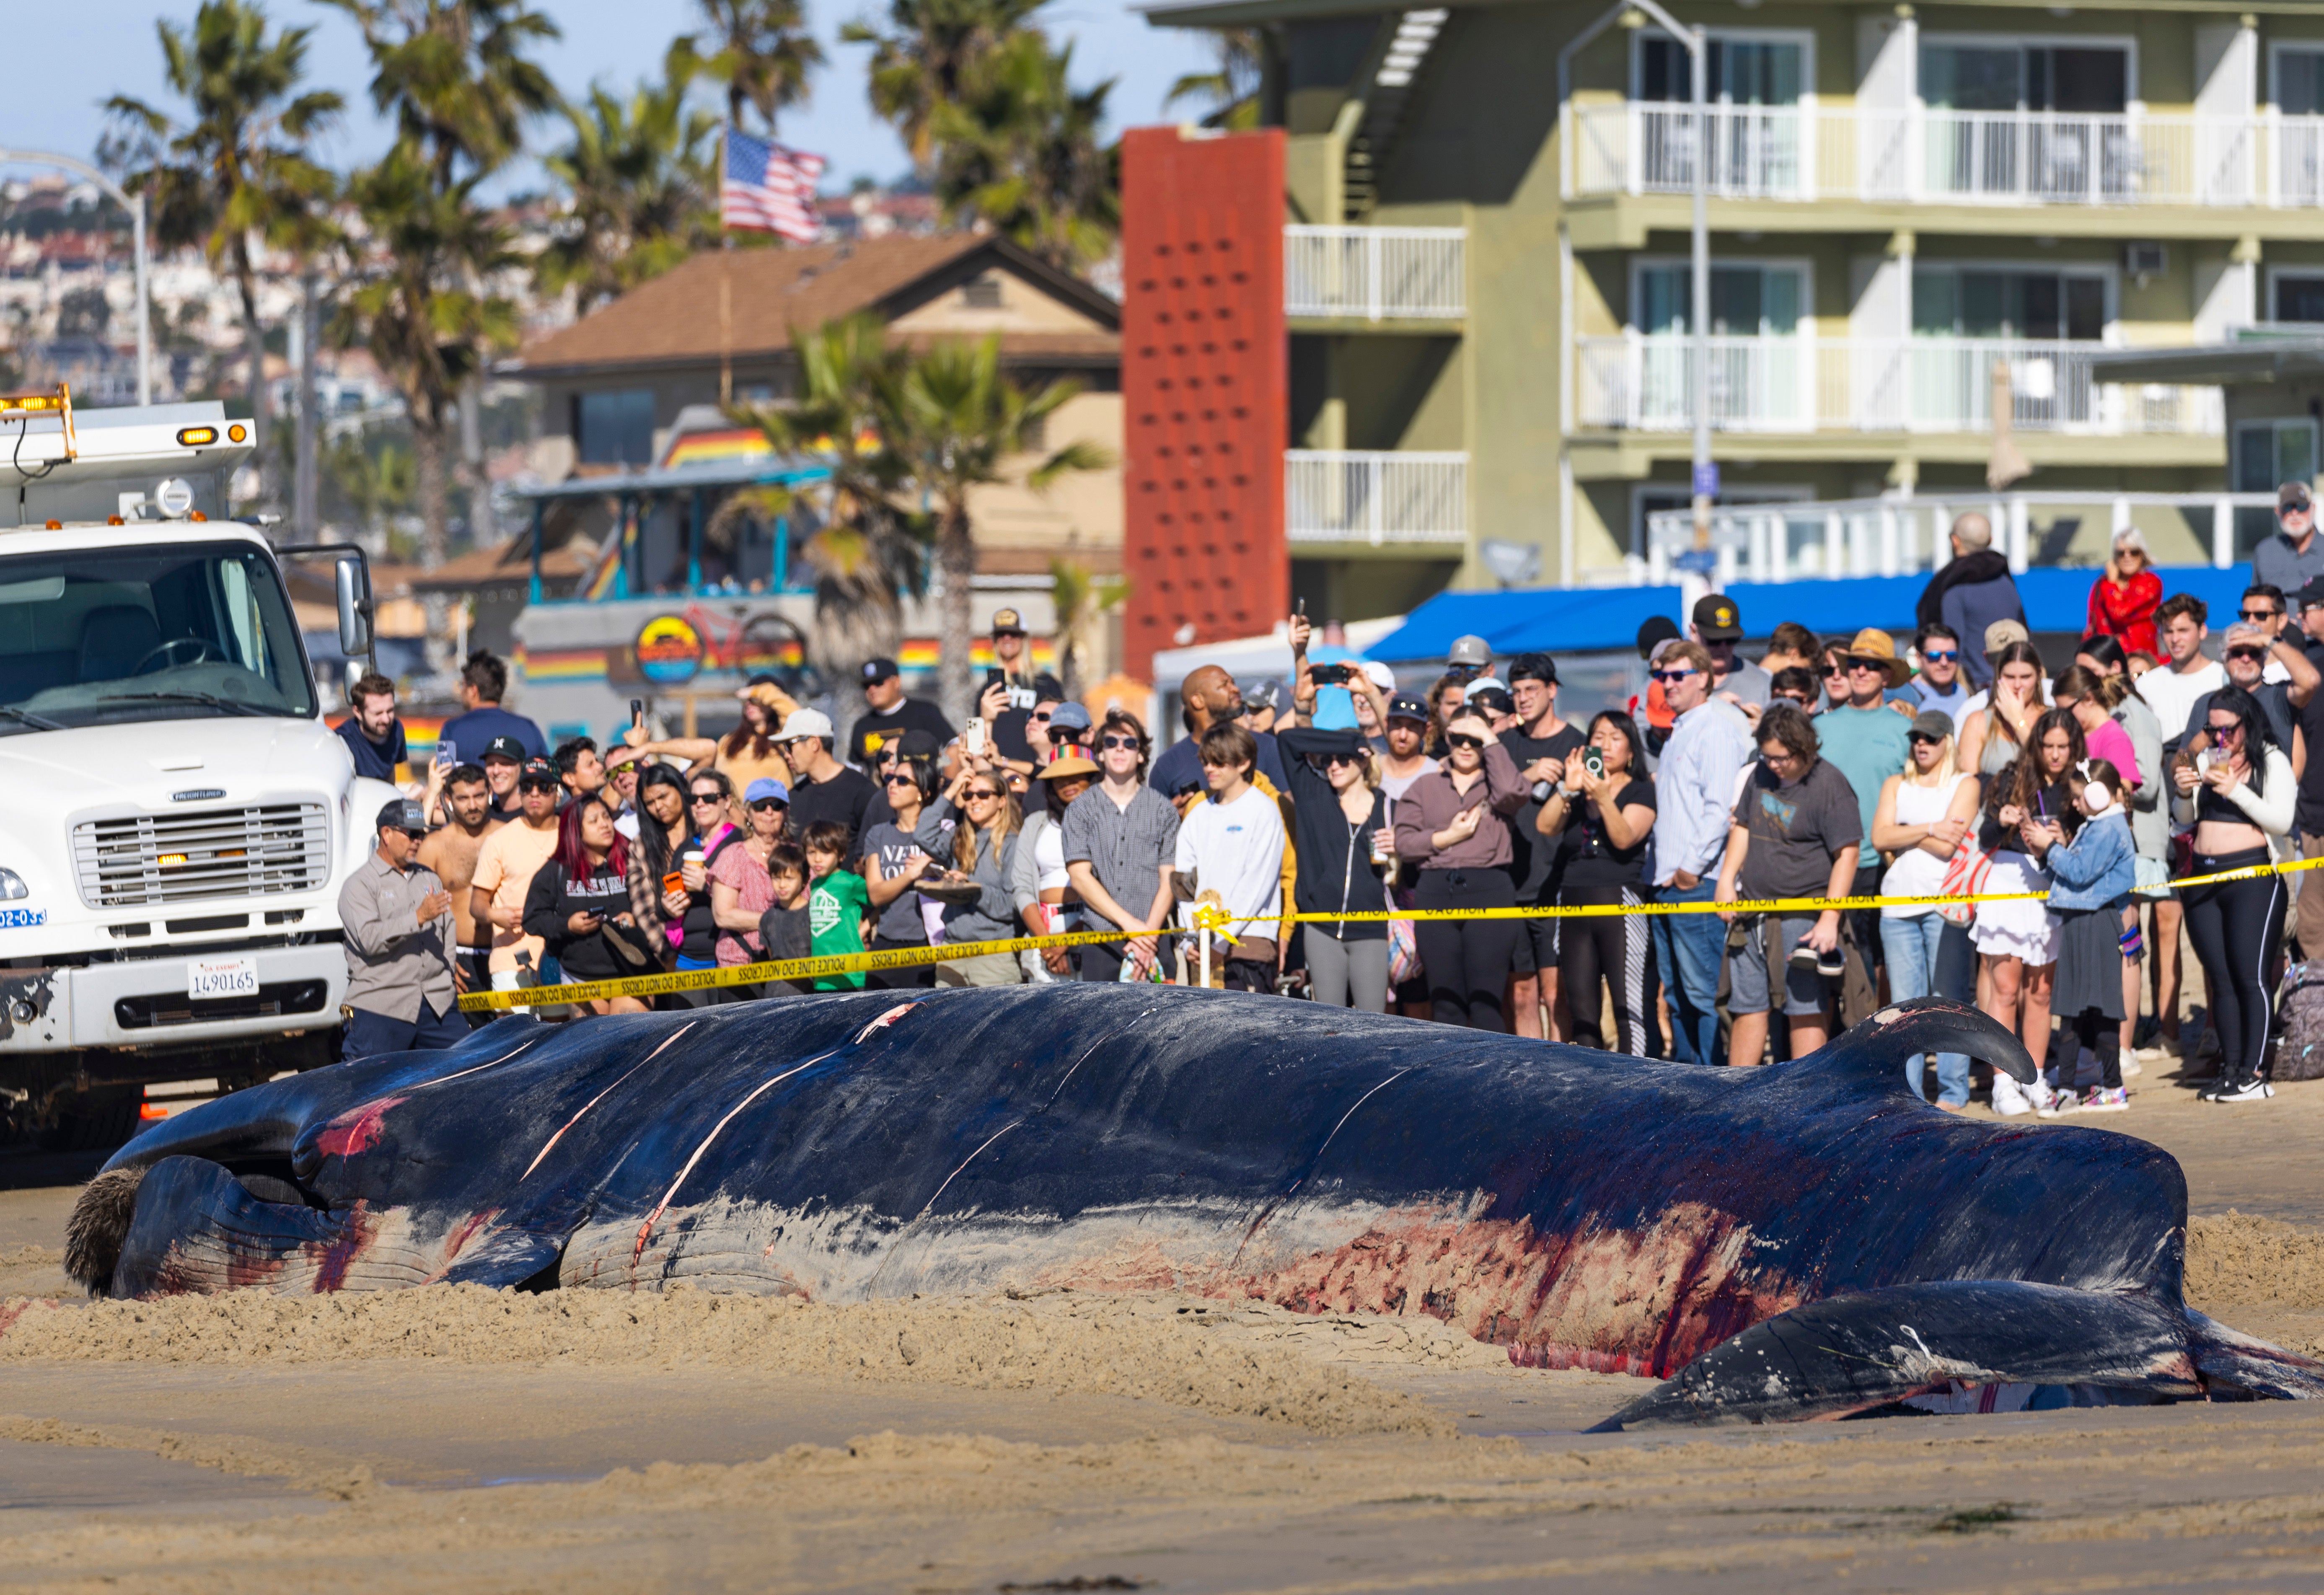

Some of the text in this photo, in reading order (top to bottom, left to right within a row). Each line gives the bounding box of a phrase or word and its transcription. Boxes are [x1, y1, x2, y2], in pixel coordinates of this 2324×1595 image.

[872, 944, 983, 967] POLICE LINE DO NOT CROSS
[738, 957, 845, 981] POLICE LINE DO NOT CROSS
[194, 971, 254, 993] 1490165
[621, 971, 715, 995] POLICE LINE DO NOT CROSS
[508, 984, 600, 1005] POLICE LINE DO NOT CROSS
